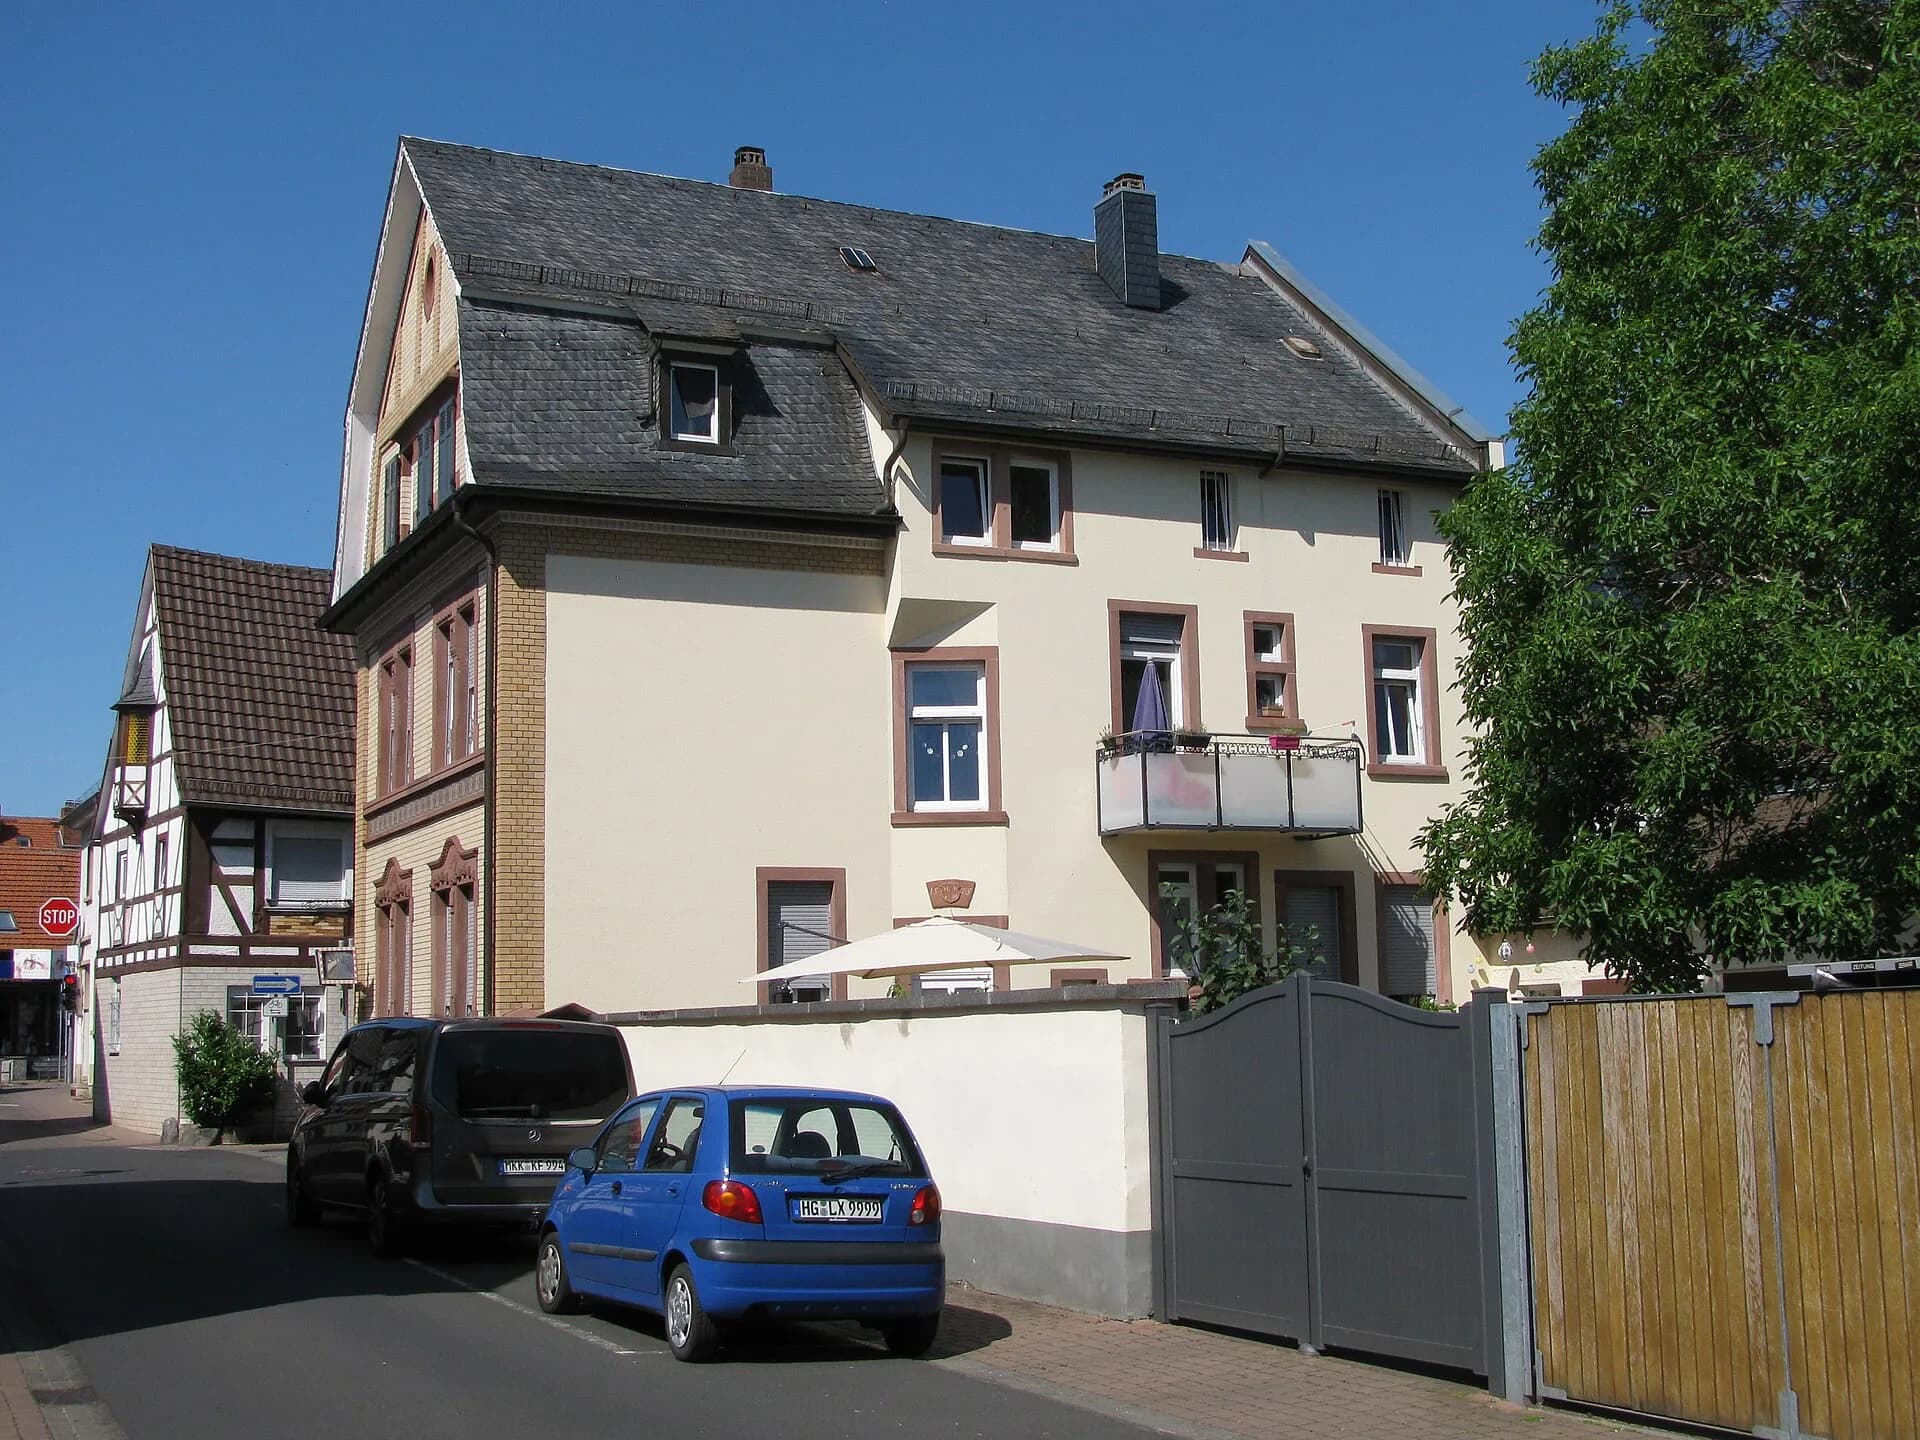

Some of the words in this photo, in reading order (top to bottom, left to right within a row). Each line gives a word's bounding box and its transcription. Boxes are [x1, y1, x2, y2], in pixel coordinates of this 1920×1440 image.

[43, 909, 75, 924] STOP
[1852, 962, 1875, 970] ZEITUNG
[531, 1160, 544, 1171] KF
[545, 1160, 565, 1171] 994
[801, 1200, 819, 1216] HG
[828, 1200, 845, 1216] LX
[848, 1201, 880, 1216] 9999
